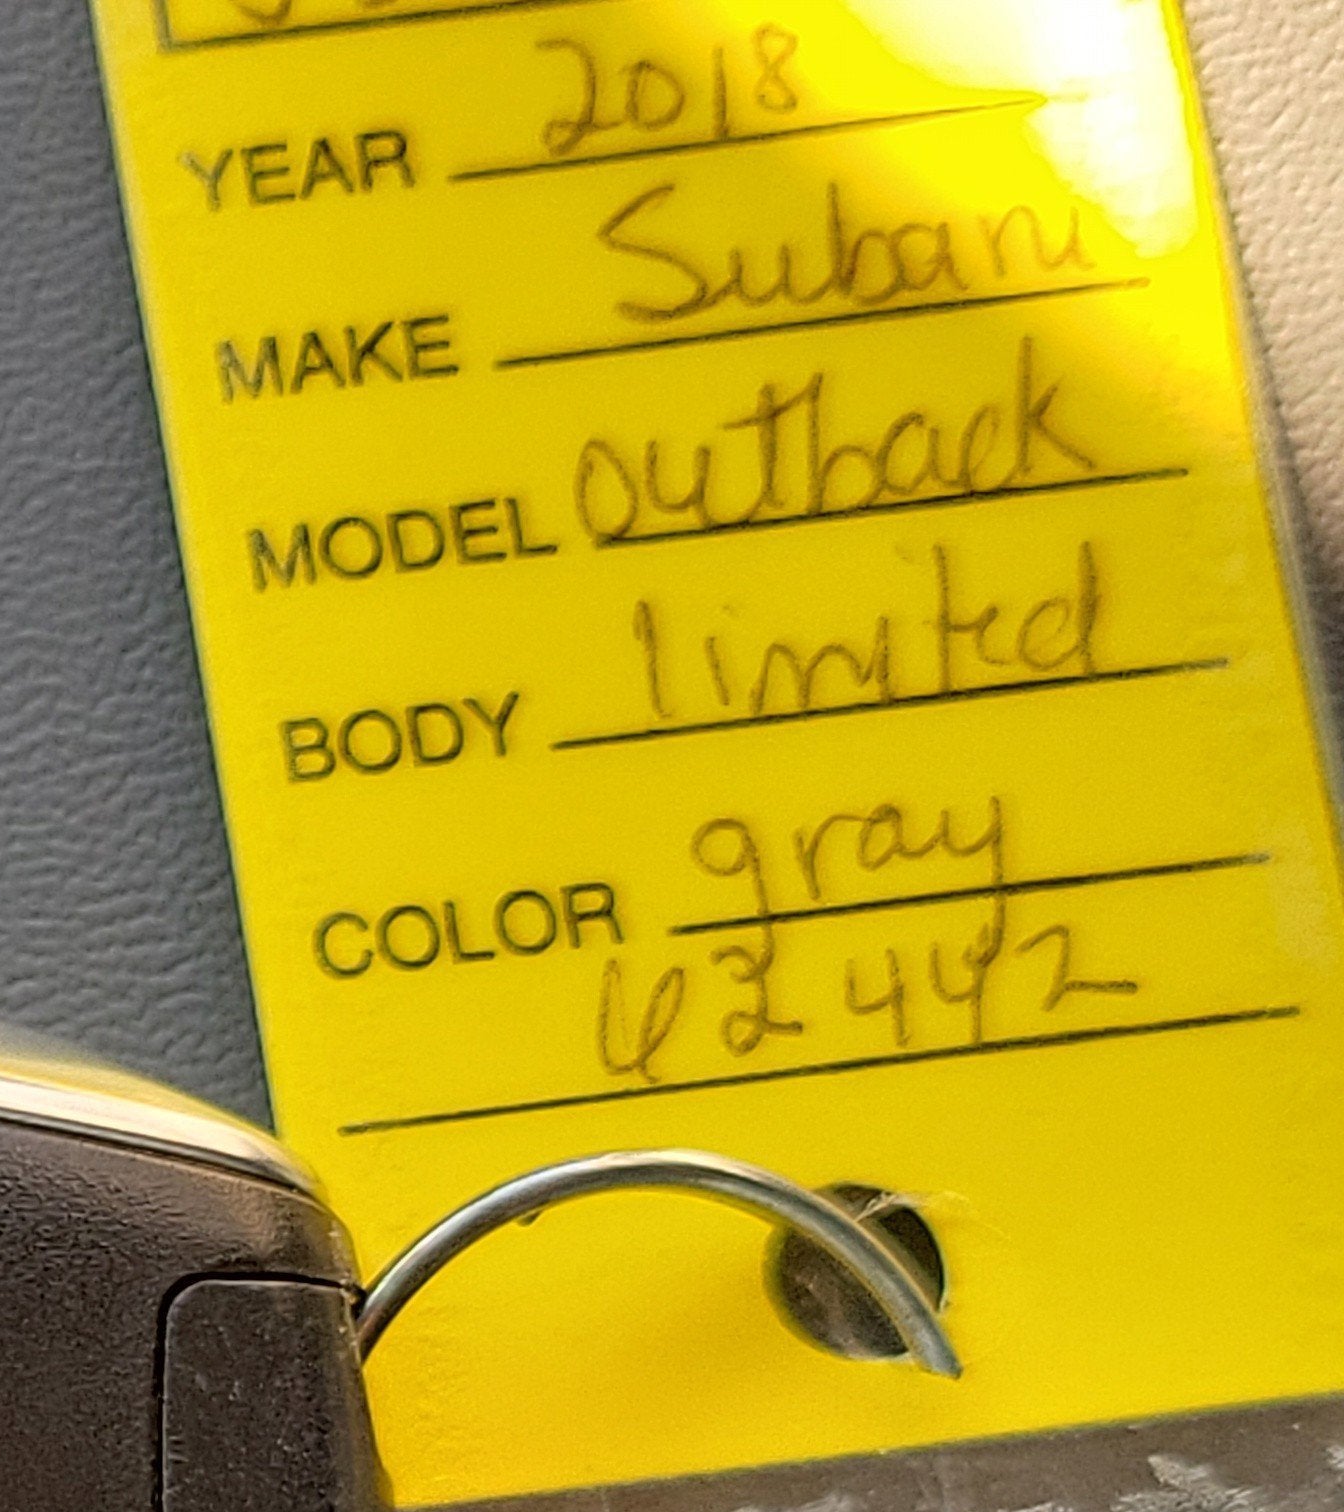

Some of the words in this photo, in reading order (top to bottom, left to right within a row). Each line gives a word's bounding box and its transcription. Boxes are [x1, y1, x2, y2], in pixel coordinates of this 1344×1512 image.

[538, 26, 802, 155] 2018
[185, 131, 416, 212] YEAR
[217, 316, 460, 404] MAKE
[249, 500, 558, 596] MODEL
[281, 693, 520, 782] BODY
[314, 881, 624, 979] COLOR
[690, 795, 1006, 970] gray
